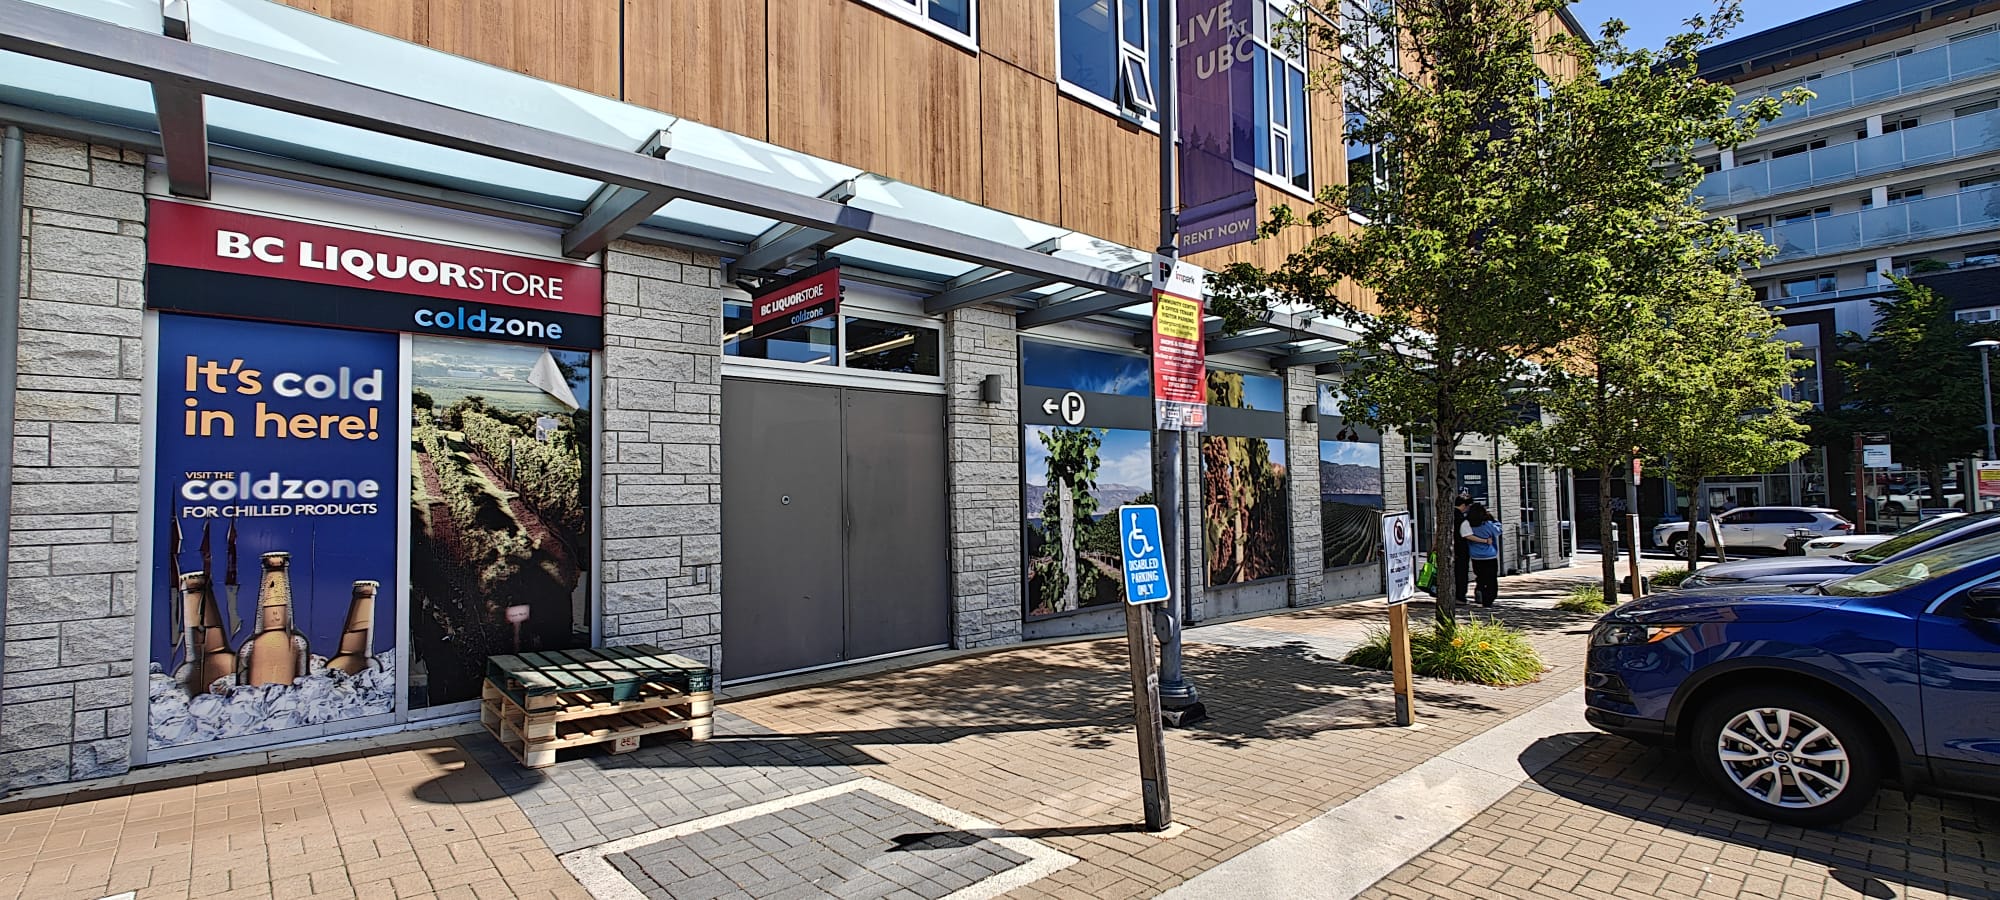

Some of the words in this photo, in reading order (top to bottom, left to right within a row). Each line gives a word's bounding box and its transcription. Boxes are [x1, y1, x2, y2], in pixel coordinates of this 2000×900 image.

[1176, 0, 1233, 49] LIVE
[1229, 19, 1248, 41] AT
[1196, 34, 1254, 80] UBC
[1183, 227, 1214, 247] RENT
[1218, 218, 1251, 237] NOW
[217, 229, 284, 264] BC
[299, 241, 564, 301] LIQUORSTORE
[1175, 271, 1195, 285] impark
[760, 303, 771, 317] BC
[772, 283, 824, 312] LIQUORSTORE
[414, 306, 563, 340] coldzone
[791, 307, 824, 325] coldzone
[185, 355, 263, 395] It's
[273, 366, 383, 401] cold
[185, 397, 235, 437] in
[255, 402, 379, 441] here!
[1068, 396, 1081, 420] P
[181, 472, 379, 500] coldzone
[185, 471, 212, 479] VISIT
[182, 506, 219, 518] FOR
[222, 505, 292, 518] CHILLED
[295, 503, 378, 516] PRODUCTS
[1128, 558, 1159, 572] DISABLED
[1131, 570, 1159, 584] PARKING
[1137, 583, 1154, 596] ONLY
